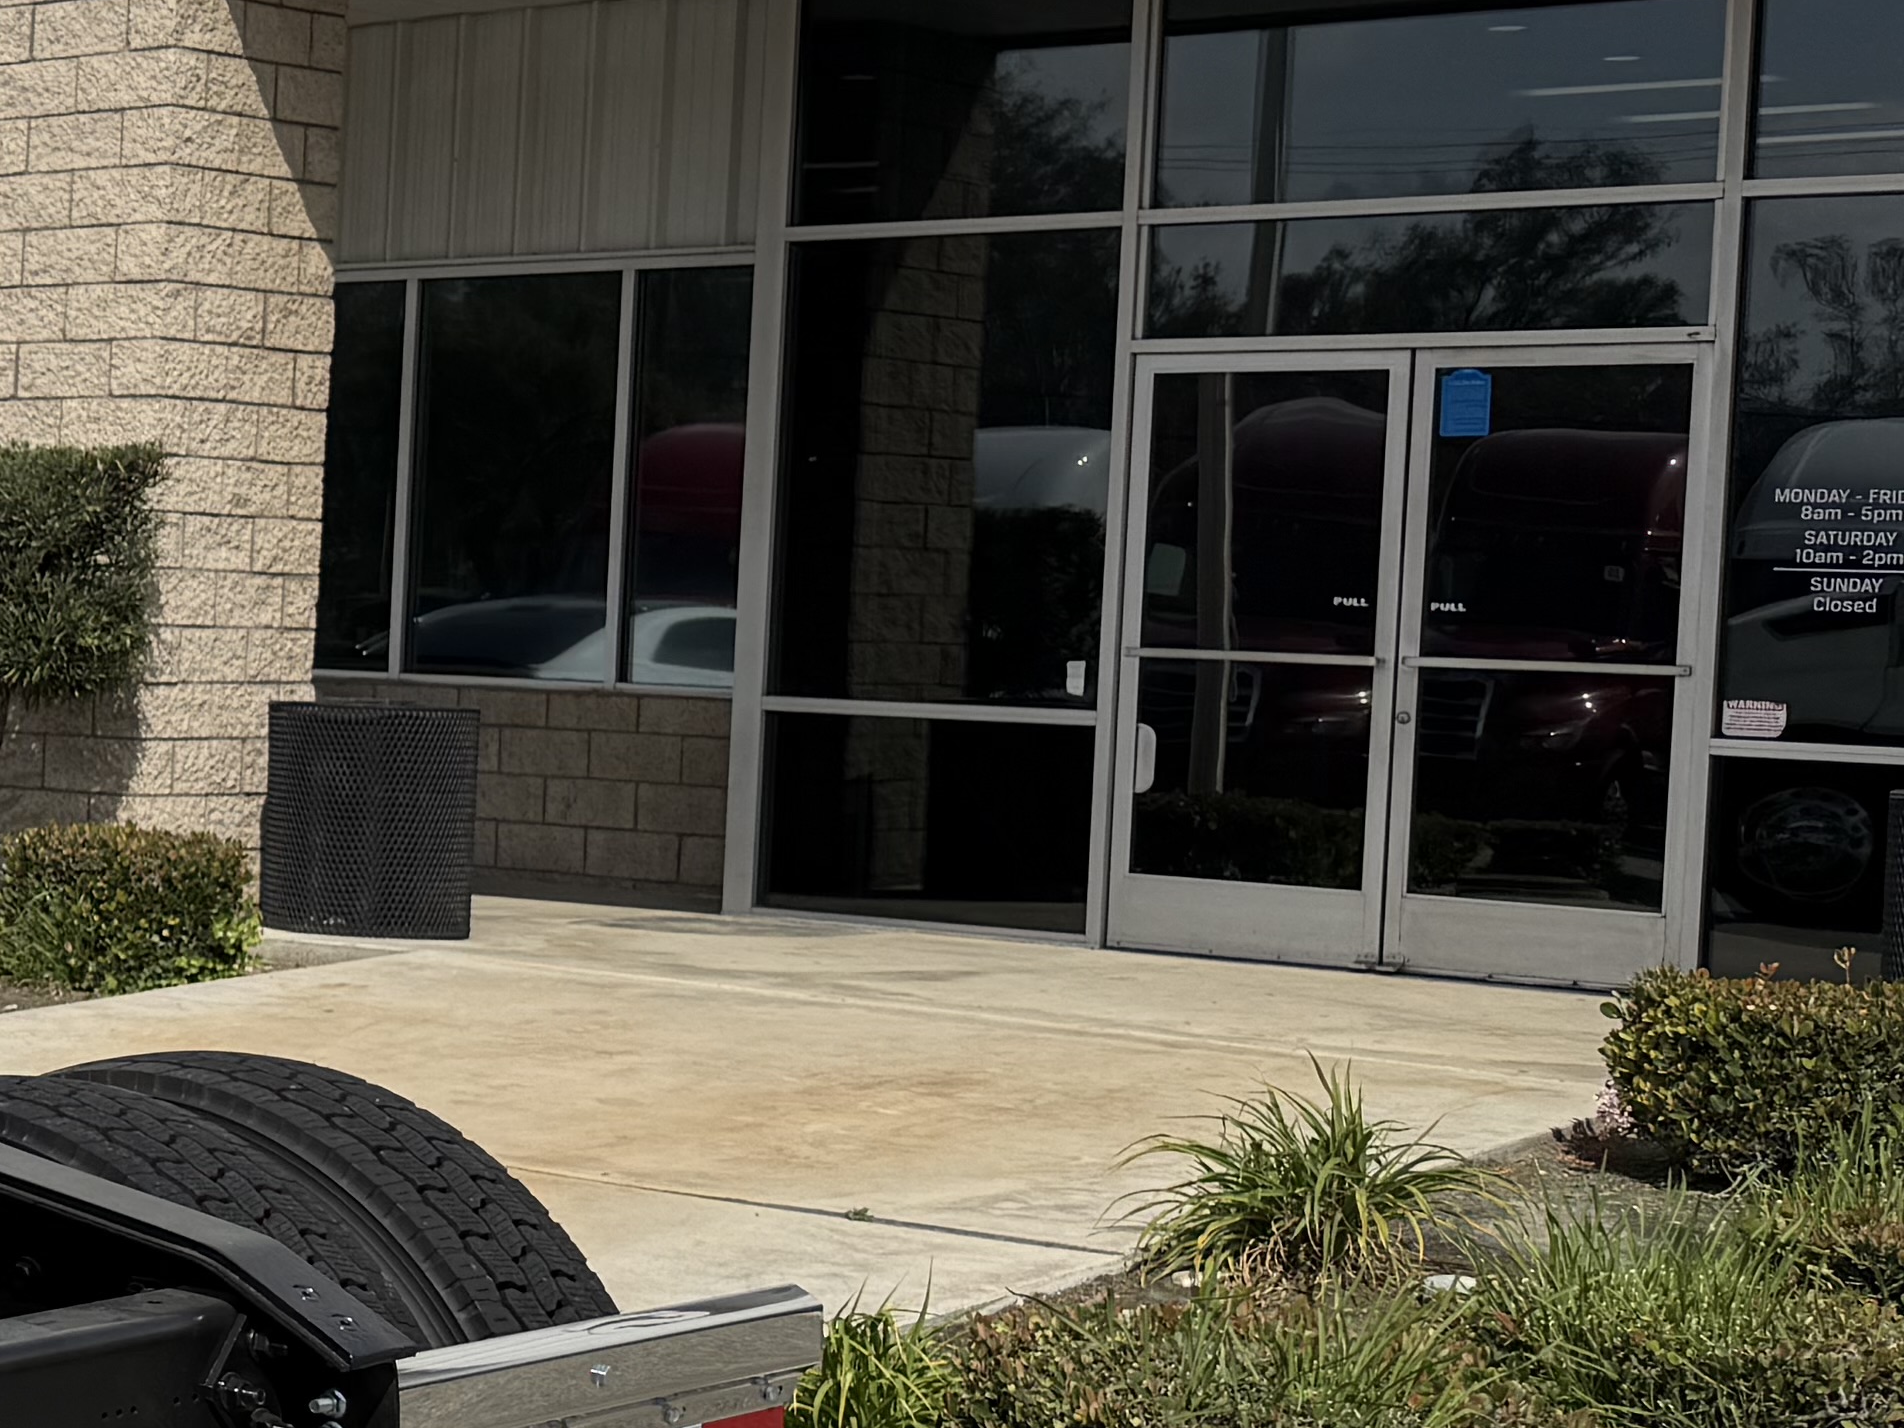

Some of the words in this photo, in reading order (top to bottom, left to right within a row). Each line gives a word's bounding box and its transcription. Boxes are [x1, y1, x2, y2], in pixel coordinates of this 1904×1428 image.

[1774, 488, 1851, 503] MONDAY
[1800, 505, 1842, 520] 8am
[1861, 506, 1903, 524] 5pm
[1804, 530, 1898, 546] SATURDAY
[1795, 548, 1843, 564] 10am
[1862, 550, 1904, 567] 2pm
[1810, 577, 1883, 593] SUNDAY
[1333, 595, 1370, 607] PULL
[1430, 601, 1467, 612] PULL
[1813, 596, 1877, 613] Closed
[1728, 699, 1784, 710] WARNING
